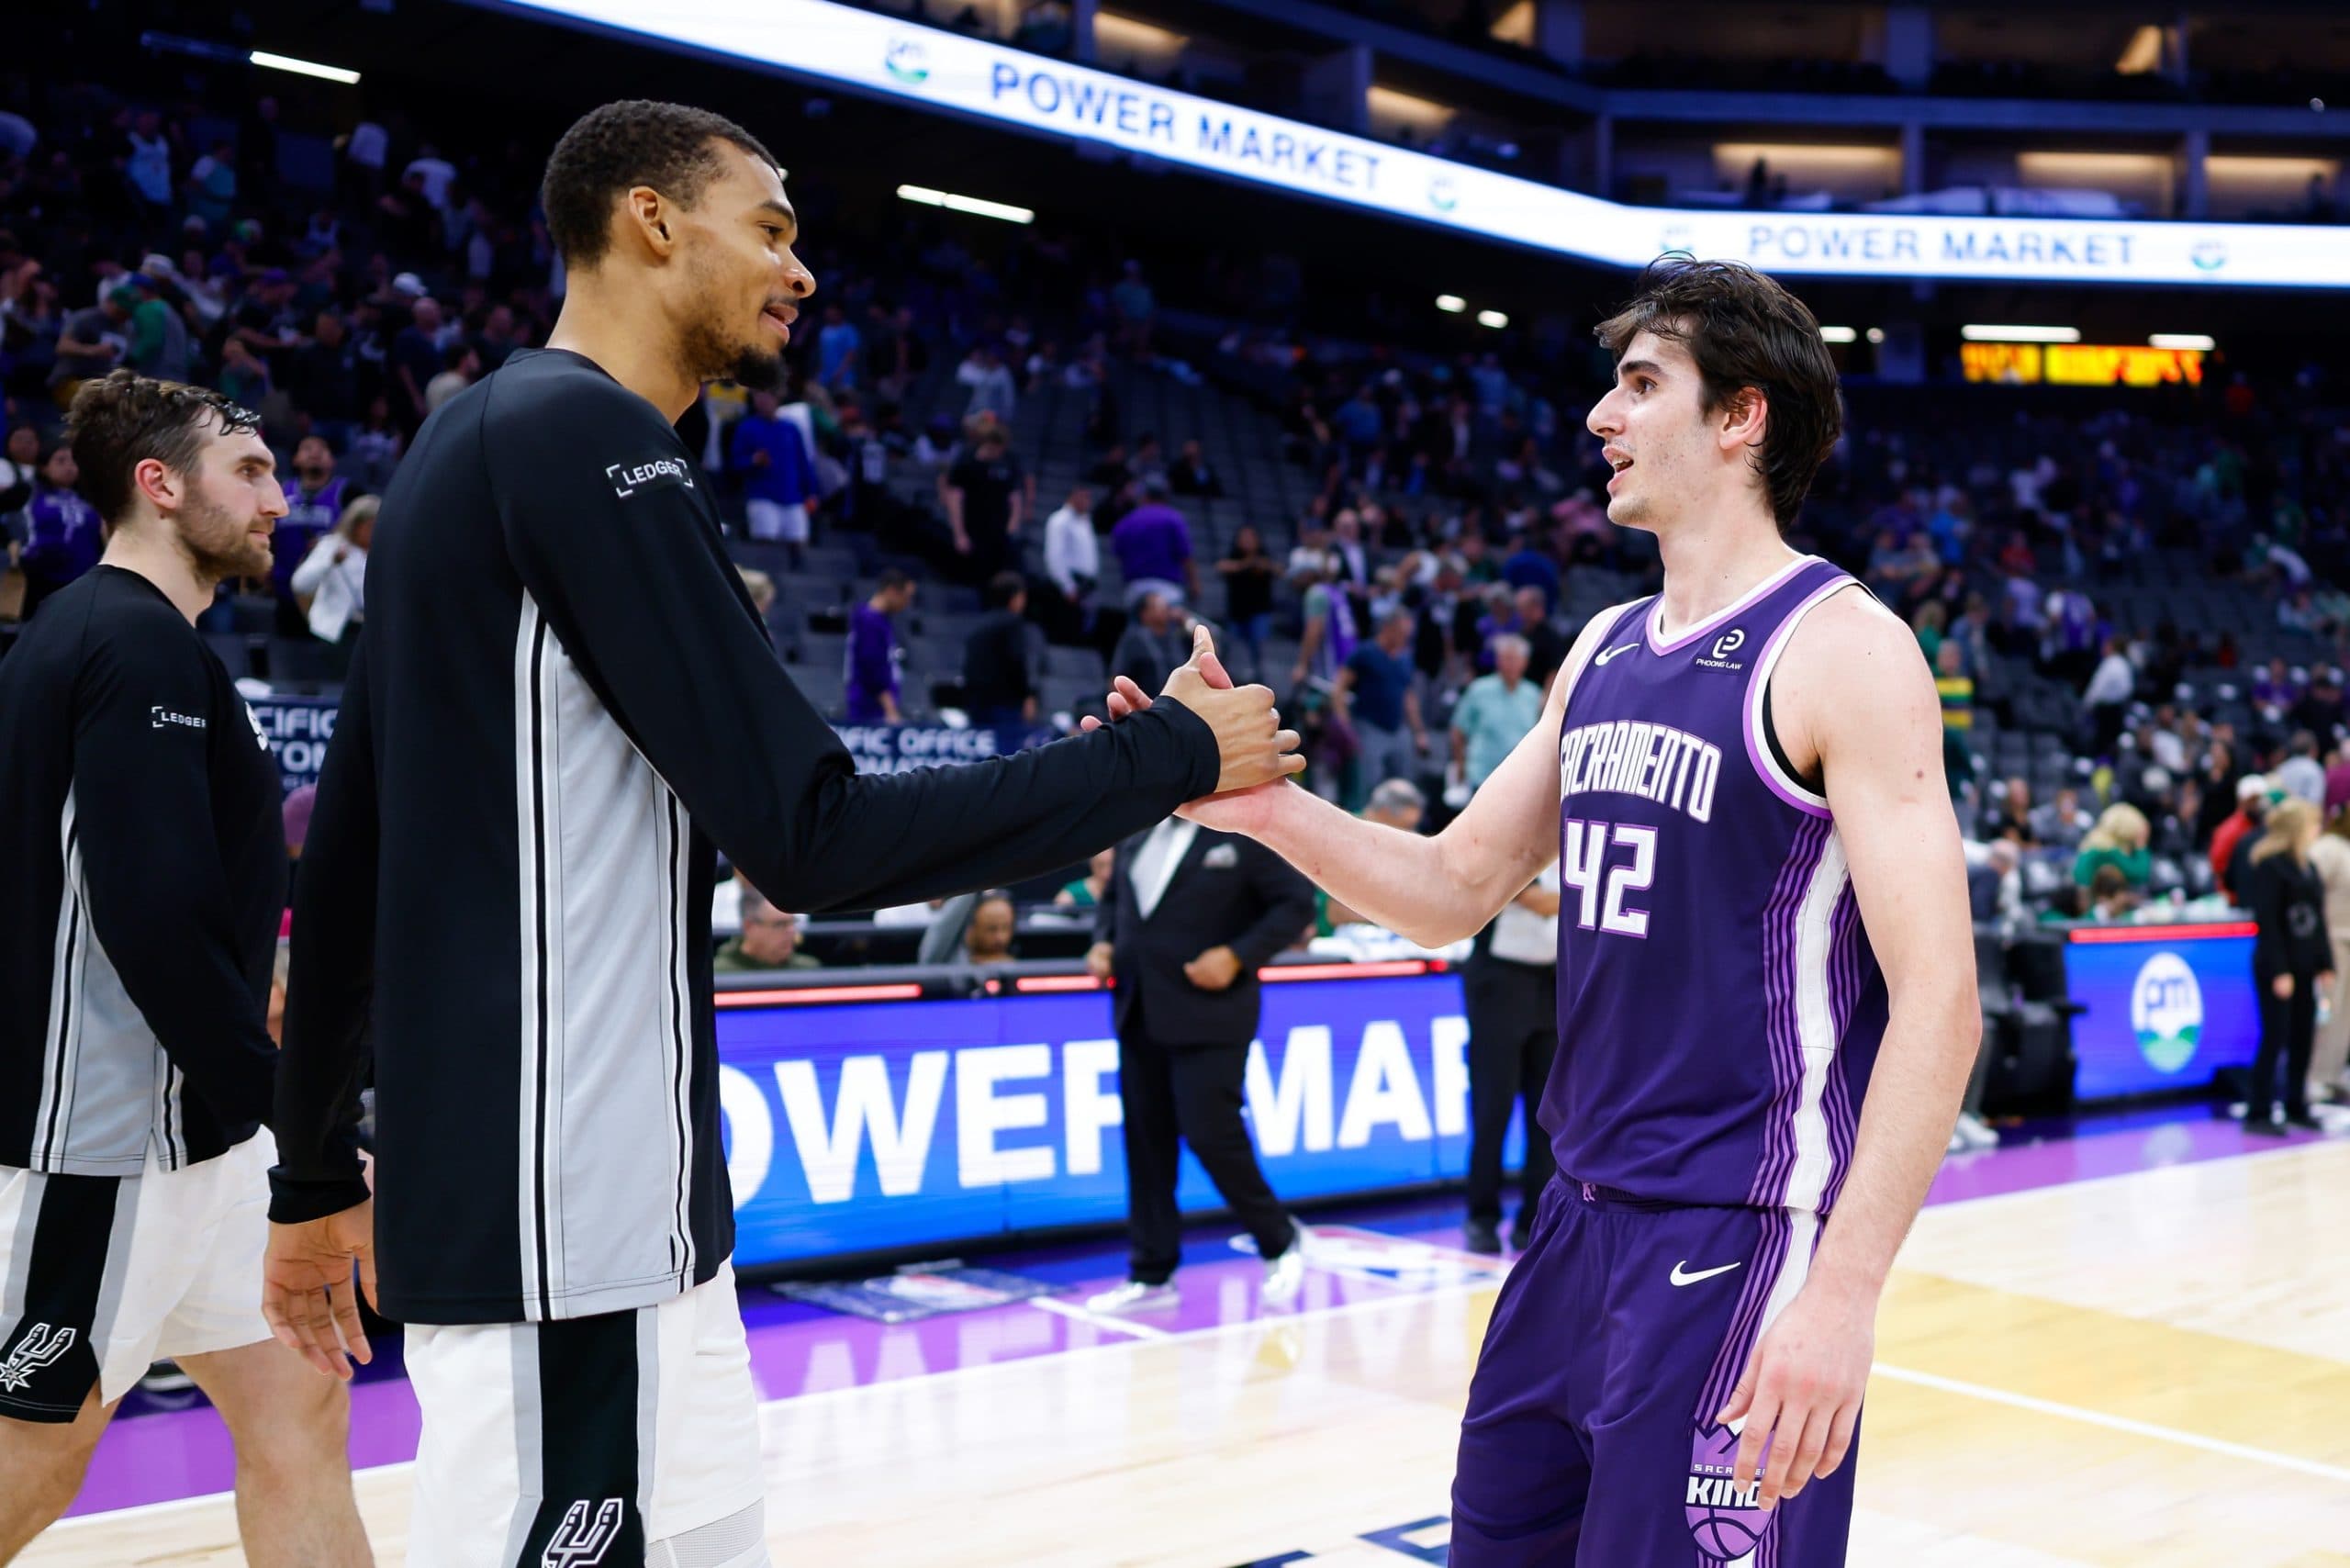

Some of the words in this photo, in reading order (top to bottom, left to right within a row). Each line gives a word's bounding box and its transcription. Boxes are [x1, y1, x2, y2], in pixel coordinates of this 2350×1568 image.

[991, 62, 1174, 142] POWER
[1199, 114, 1382, 190] MARKET
[1750, 225, 1919, 261] POWER
[1941, 230, 2137, 265] MARKET
[622, 460, 682, 486] LEDGER
[1696, 658, 1726, 668] PHOONG
[1726, 662, 1742, 670] LAW
[898, 728, 996, 756] OFFICE
[1562, 818, 1658, 939] 42
[1694, 1463, 1764, 1475] SACRE
